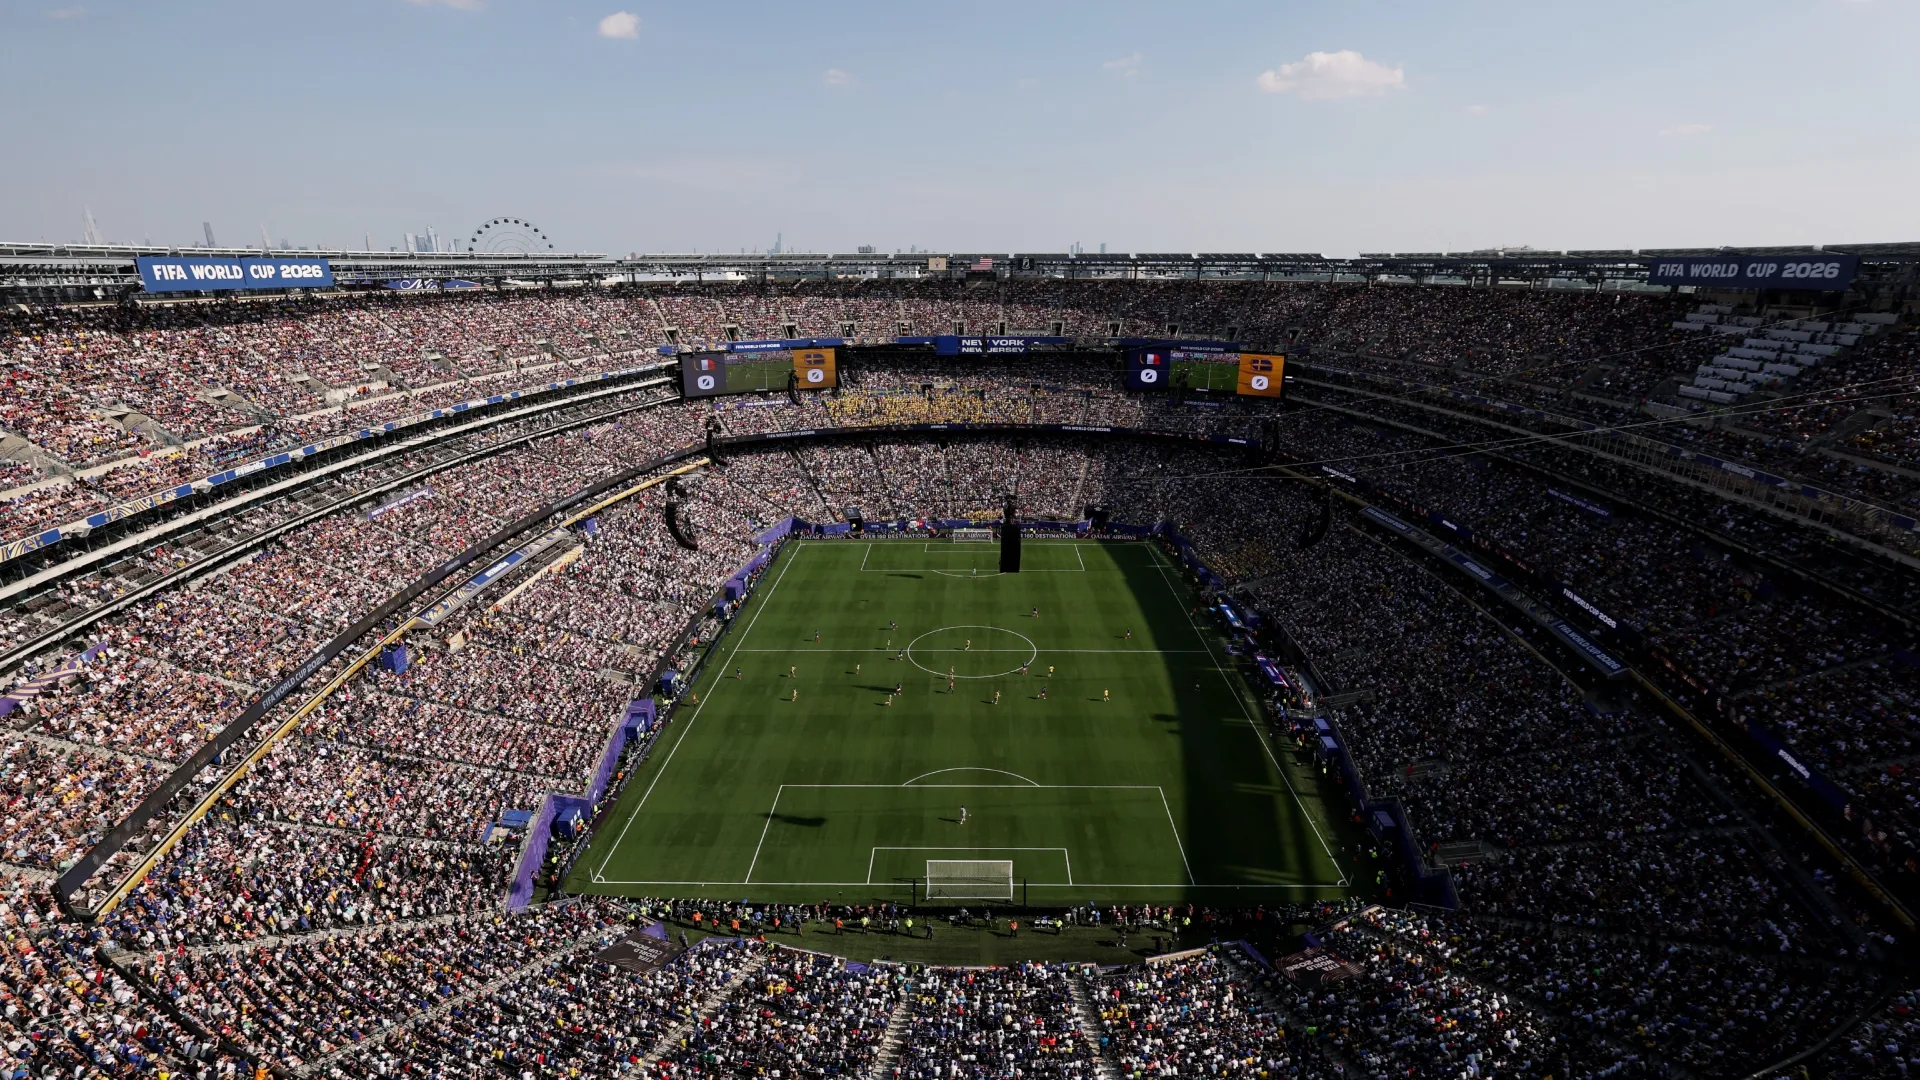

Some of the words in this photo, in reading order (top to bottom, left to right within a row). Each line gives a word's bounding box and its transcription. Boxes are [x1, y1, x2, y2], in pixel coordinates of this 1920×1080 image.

[152, 265, 188, 280] FIFA
[190, 265, 244, 280] WORLD
[250, 265, 276, 279] CUP
[280, 265, 323, 278] 2026
[1657, 264, 1684, 277] FIFA
[1690, 264, 1739, 278] WORLD
[1746, 263, 1777, 278] CUP
[1781, 262, 1841, 278] 2026
[1563, 588, 1574, 600] FIFA
[1573, 594, 1590, 610] WORLD
[1589, 605, 1600, 616] CUP
[1598, 612, 1617, 629] 2026
[1557, 624, 1572, 634] FIFA
[1568, 631, 1590, 648] WORLD
[1586, 645, 1601, 655] CUP
[1596, 653, 1621, 670] 2026
[262, 694, 276, 710] FIFA
[274, 677, 296, 697] WORLD
[295, 668, 307, 681] CUP
[306, 653, 327, 673] 2026
[648, 948, 663, 956] CUP
[1313, 955, 1328, 963] CUP
[1306, 960, 1335, 971] WORLD
[1322, 962, 1340, 971] FIFA
